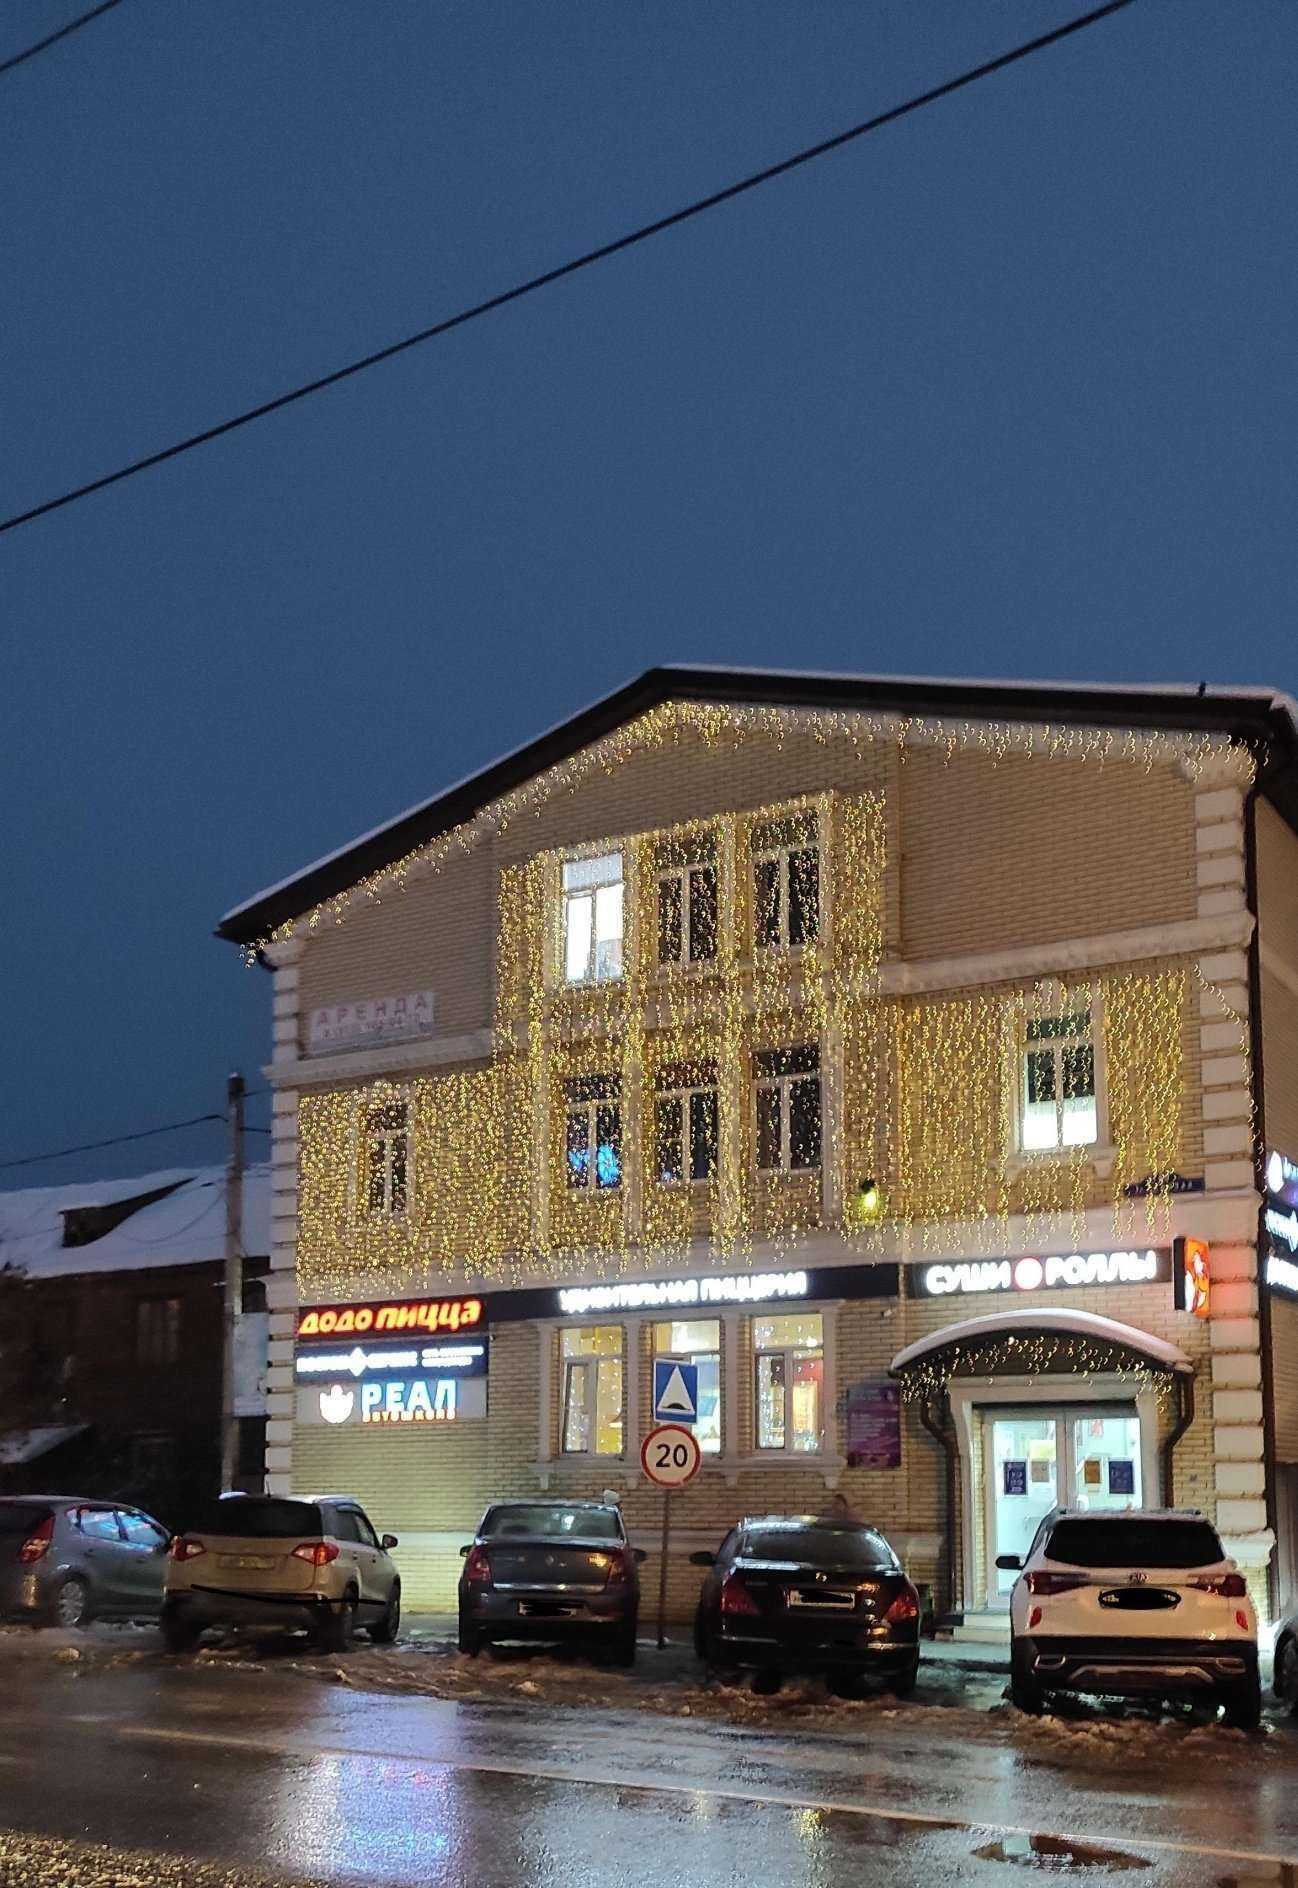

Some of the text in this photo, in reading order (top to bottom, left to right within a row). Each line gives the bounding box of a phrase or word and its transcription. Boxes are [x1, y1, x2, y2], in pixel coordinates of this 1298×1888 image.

[1046, 1250, 1157, 1286] РОЛЛЫ
[361, 1379, 456, 1411] РЕАЛ
[655, 1443, 688, 1468] 20
